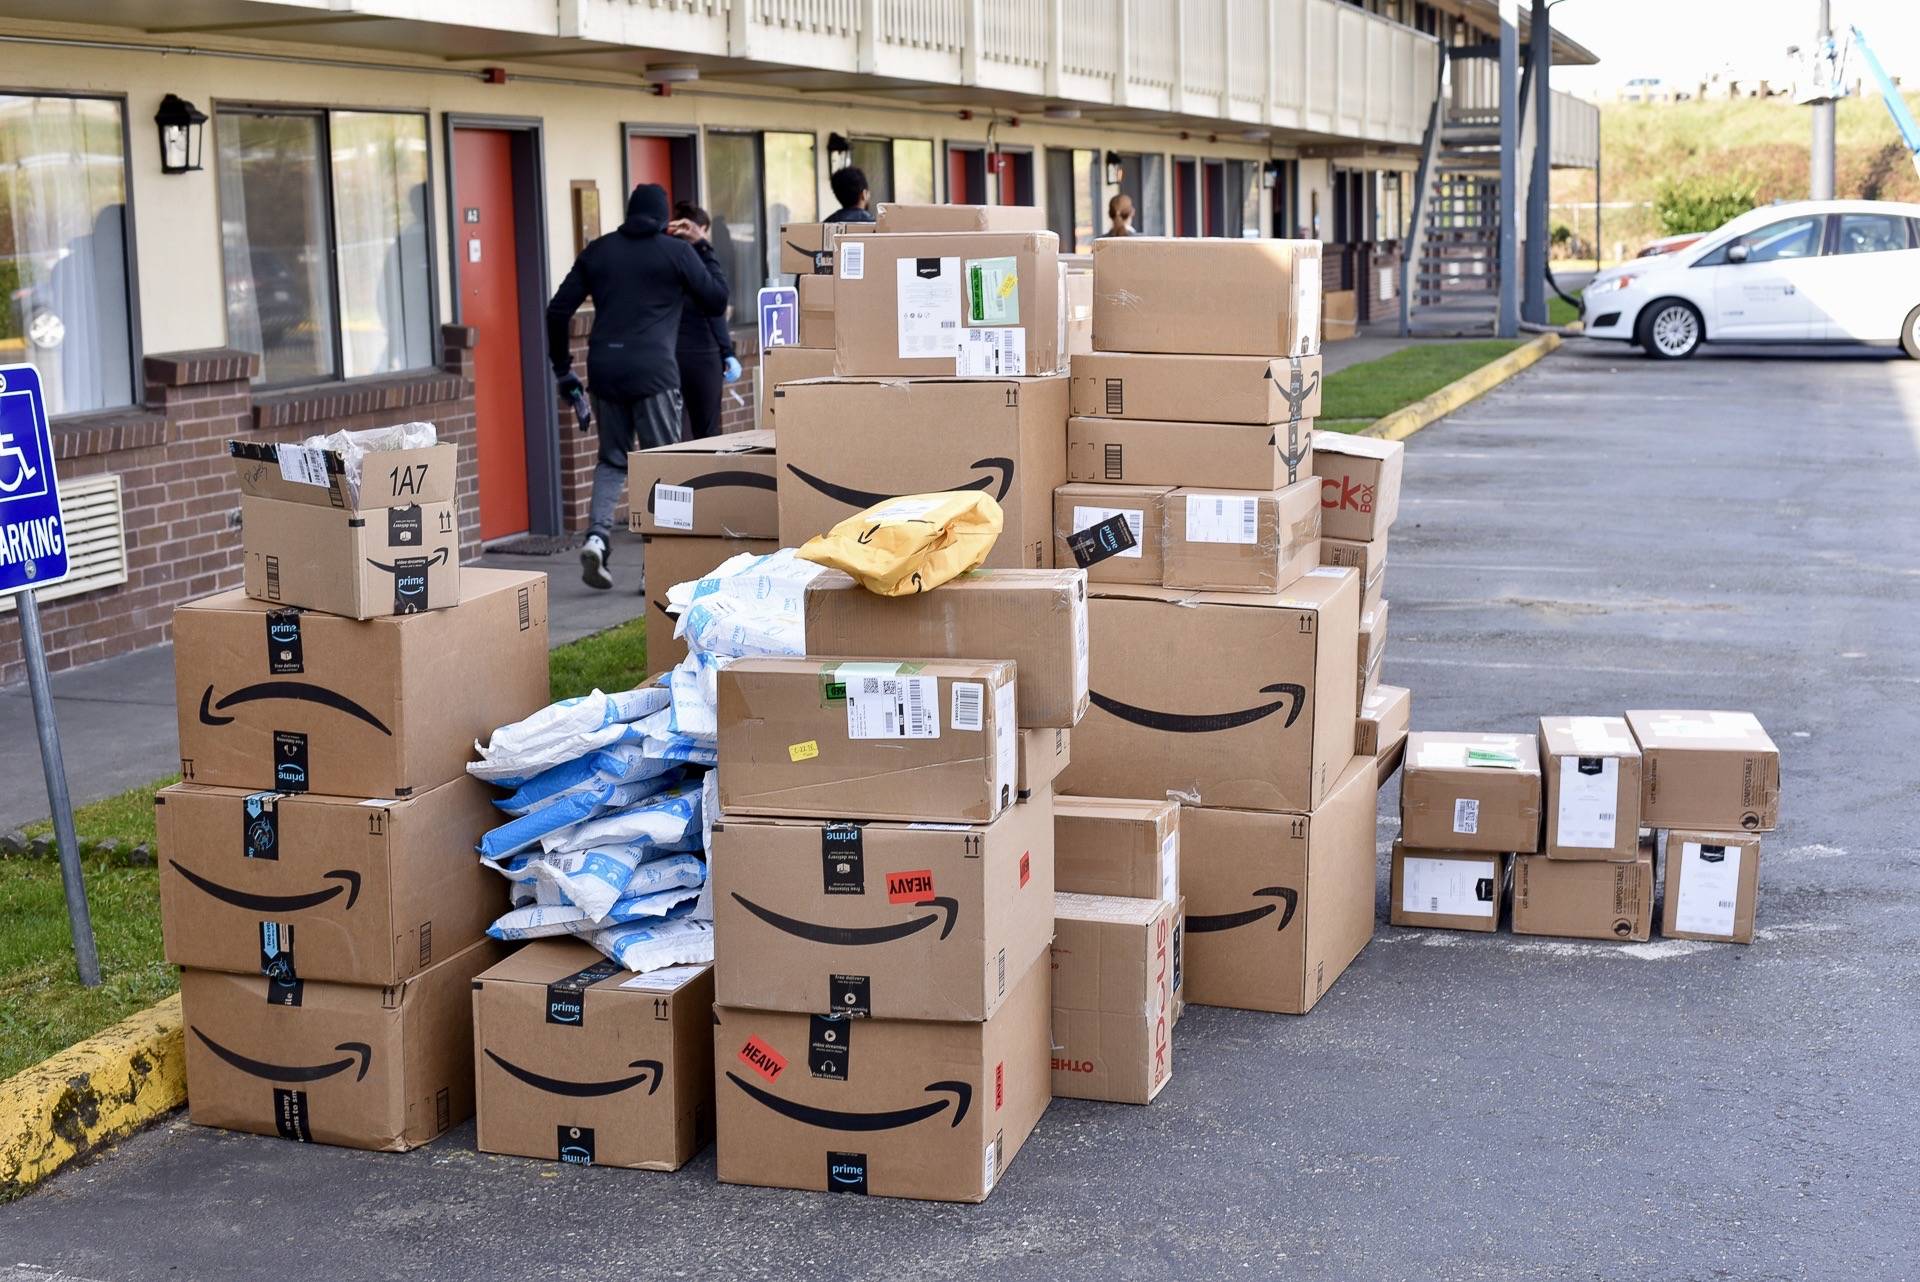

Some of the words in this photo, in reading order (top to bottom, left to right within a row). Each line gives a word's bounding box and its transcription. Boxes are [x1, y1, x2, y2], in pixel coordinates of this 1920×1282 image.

[389, 464, 428, 496] 1A7
[1360, 484, 1375, 513] BOX
[1102, 524, 1119, 549] prime
[398, 576, 424, 588] prime
[271, 623, 297, 634] prime
[278, 771, 305, 782] prime
[1743, 757, 1753, 807] COMPOSTABLE
[826, 831, 858, 842] prime
[889, 876, 932, 895] HEAVY
[1615, 865, 1625, 914] COMPOSTABLE
[551, 1002, 580, 1013] prime
[742, 1042, 782, 1077] HEAVY
[293, 1104, 298, 1114] to
[832, 1163, 863, 1175] prime
